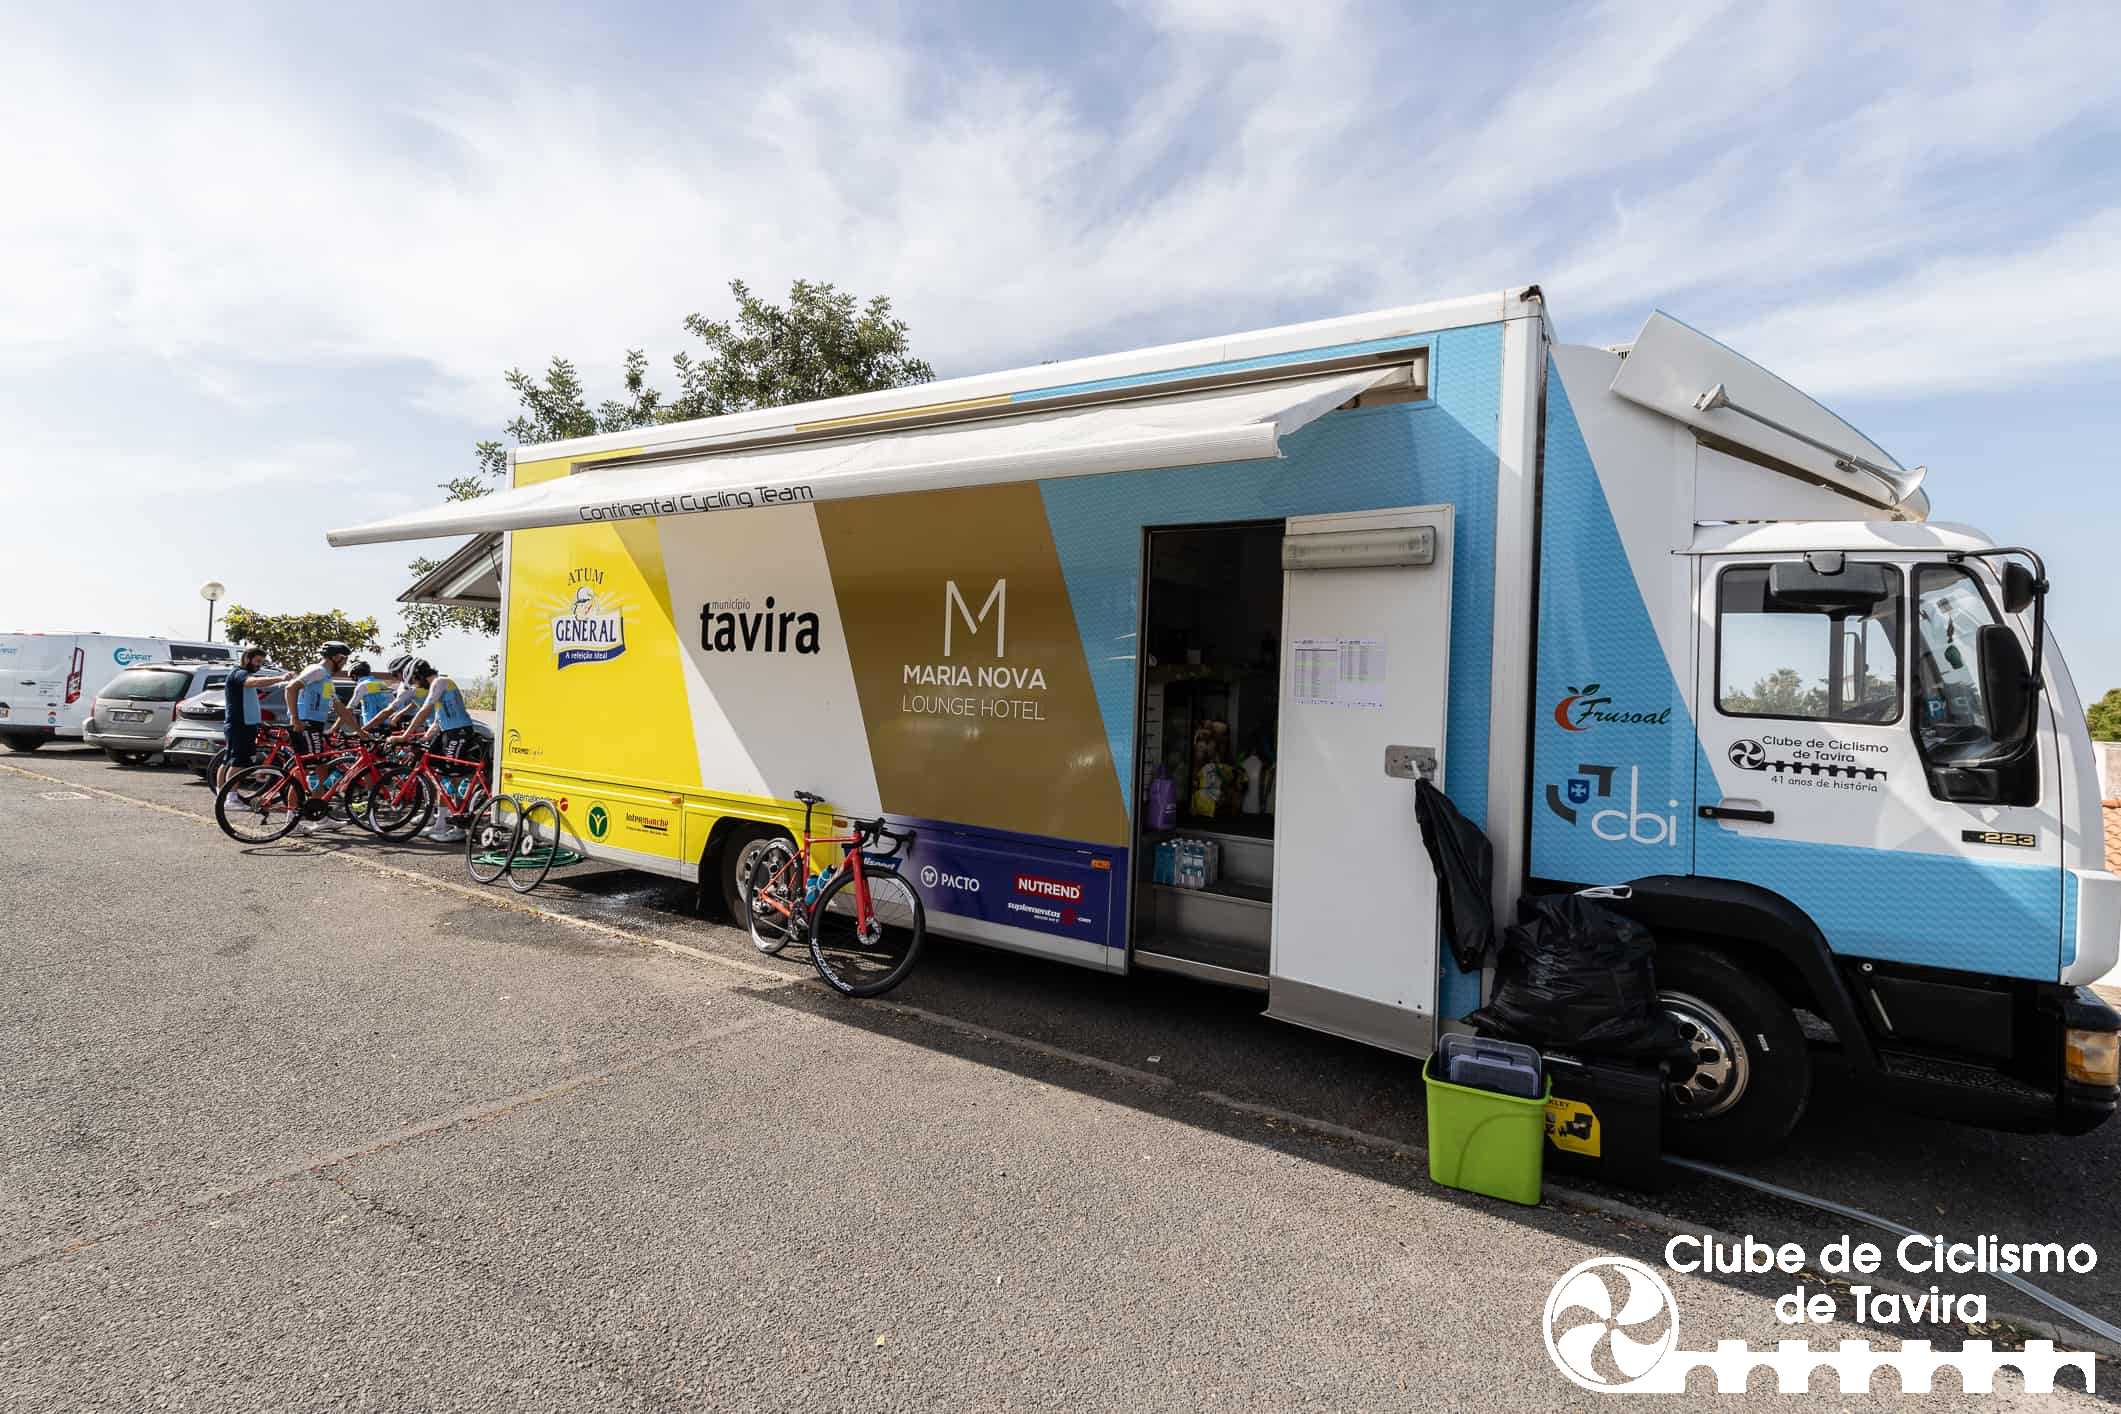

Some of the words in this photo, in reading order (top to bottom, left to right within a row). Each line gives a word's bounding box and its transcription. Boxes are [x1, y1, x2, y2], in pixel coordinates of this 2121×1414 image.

[579, 498, 676, 521] Continental
[680, 490, 754, 513] Cycling
[755, 484, 814, 503] Team
[568, 567, 604, 586] ATUM
[700, 596, 821, 654] tavira
[944, 578, 1006, 658] M
[556, 619, 616, 642] GENERAL
[903, 664, 973, 687] MARIA
[978, 667, 1048, 690] NOVA
[902, 695, 976, 717] LOUNGE
[981, 699, 1046, 721] HOTEL
[1576, 697, 1671, 725] Frusoal
[1762, 735, 1802, 747] Clube
[1806, 738, 1825, 749] de
[1828, 739, 1889, 753] Ciclismo
[1792, 750, 1810, 759] de
[1814, 751, 1855, 763] Tavira
[1771, 775, 1784, 785] 41
[1788, 777, 1813, 787] anos
[1816, 778, 1830, 788] de
[1833, 778, 1878, 792] história
[1591, 765, 1679, 847] cbi
[940, 873, 981, 892] PACTO
[1018, 878, 1080, 899] NUTREND
